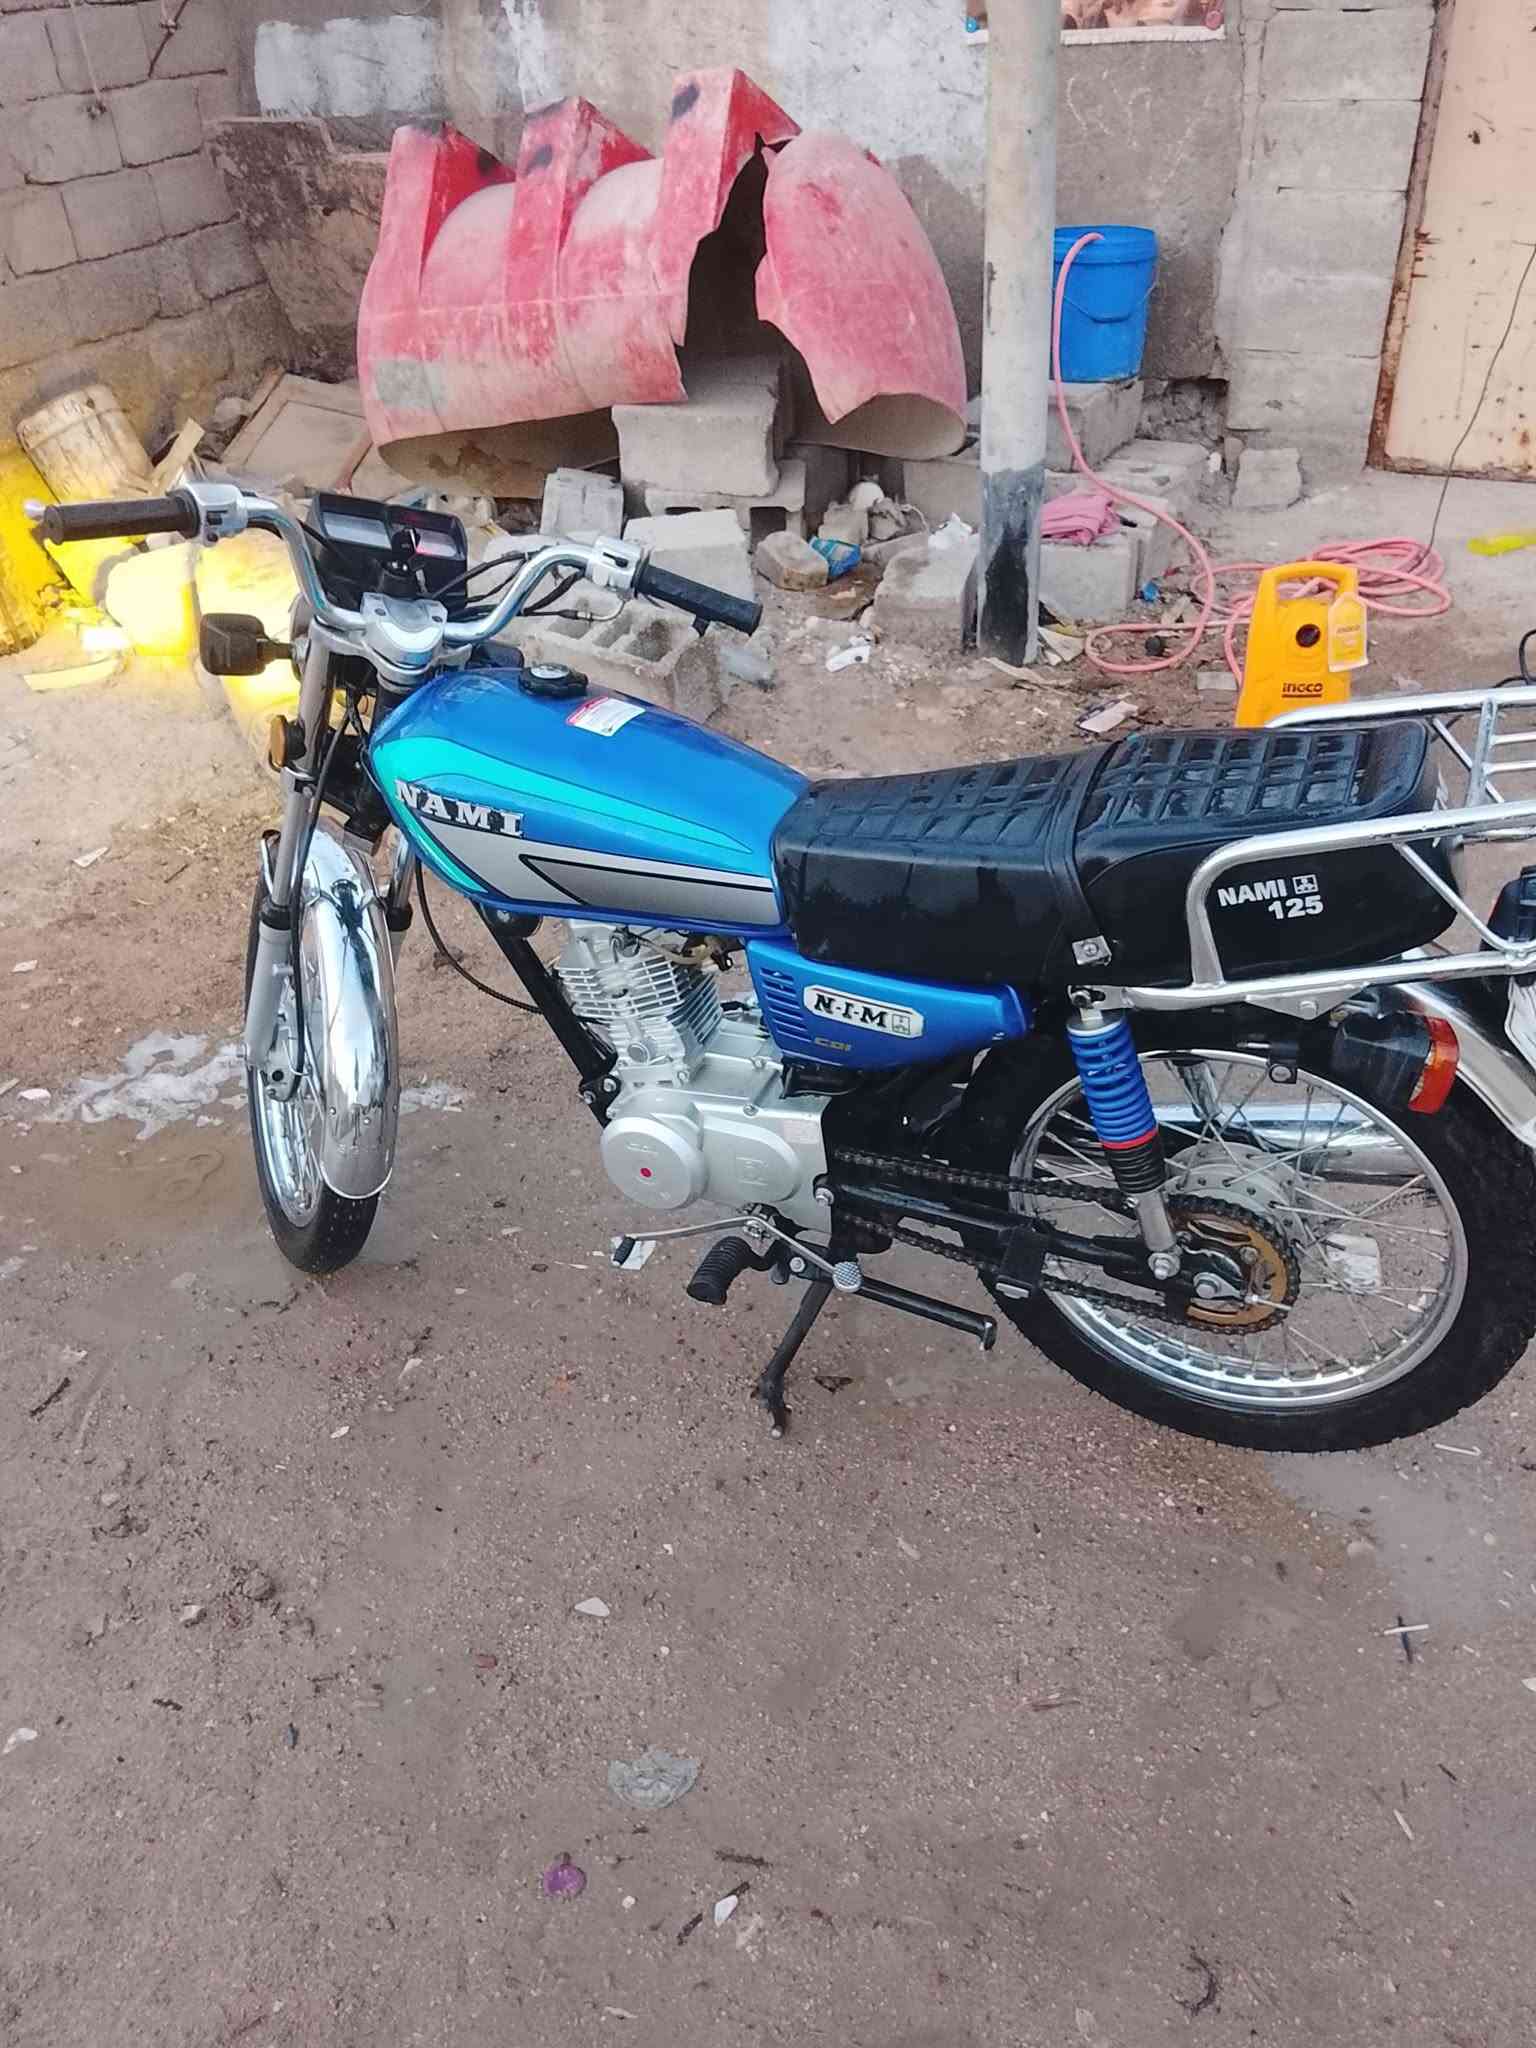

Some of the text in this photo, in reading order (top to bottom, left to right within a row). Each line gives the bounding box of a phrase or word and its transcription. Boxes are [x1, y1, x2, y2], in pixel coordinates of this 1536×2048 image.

[394, 779, 524, 836] NAMI
[1217, 879, 1288, 907] NAMI
[1268, 895, 1324, 920] 125
